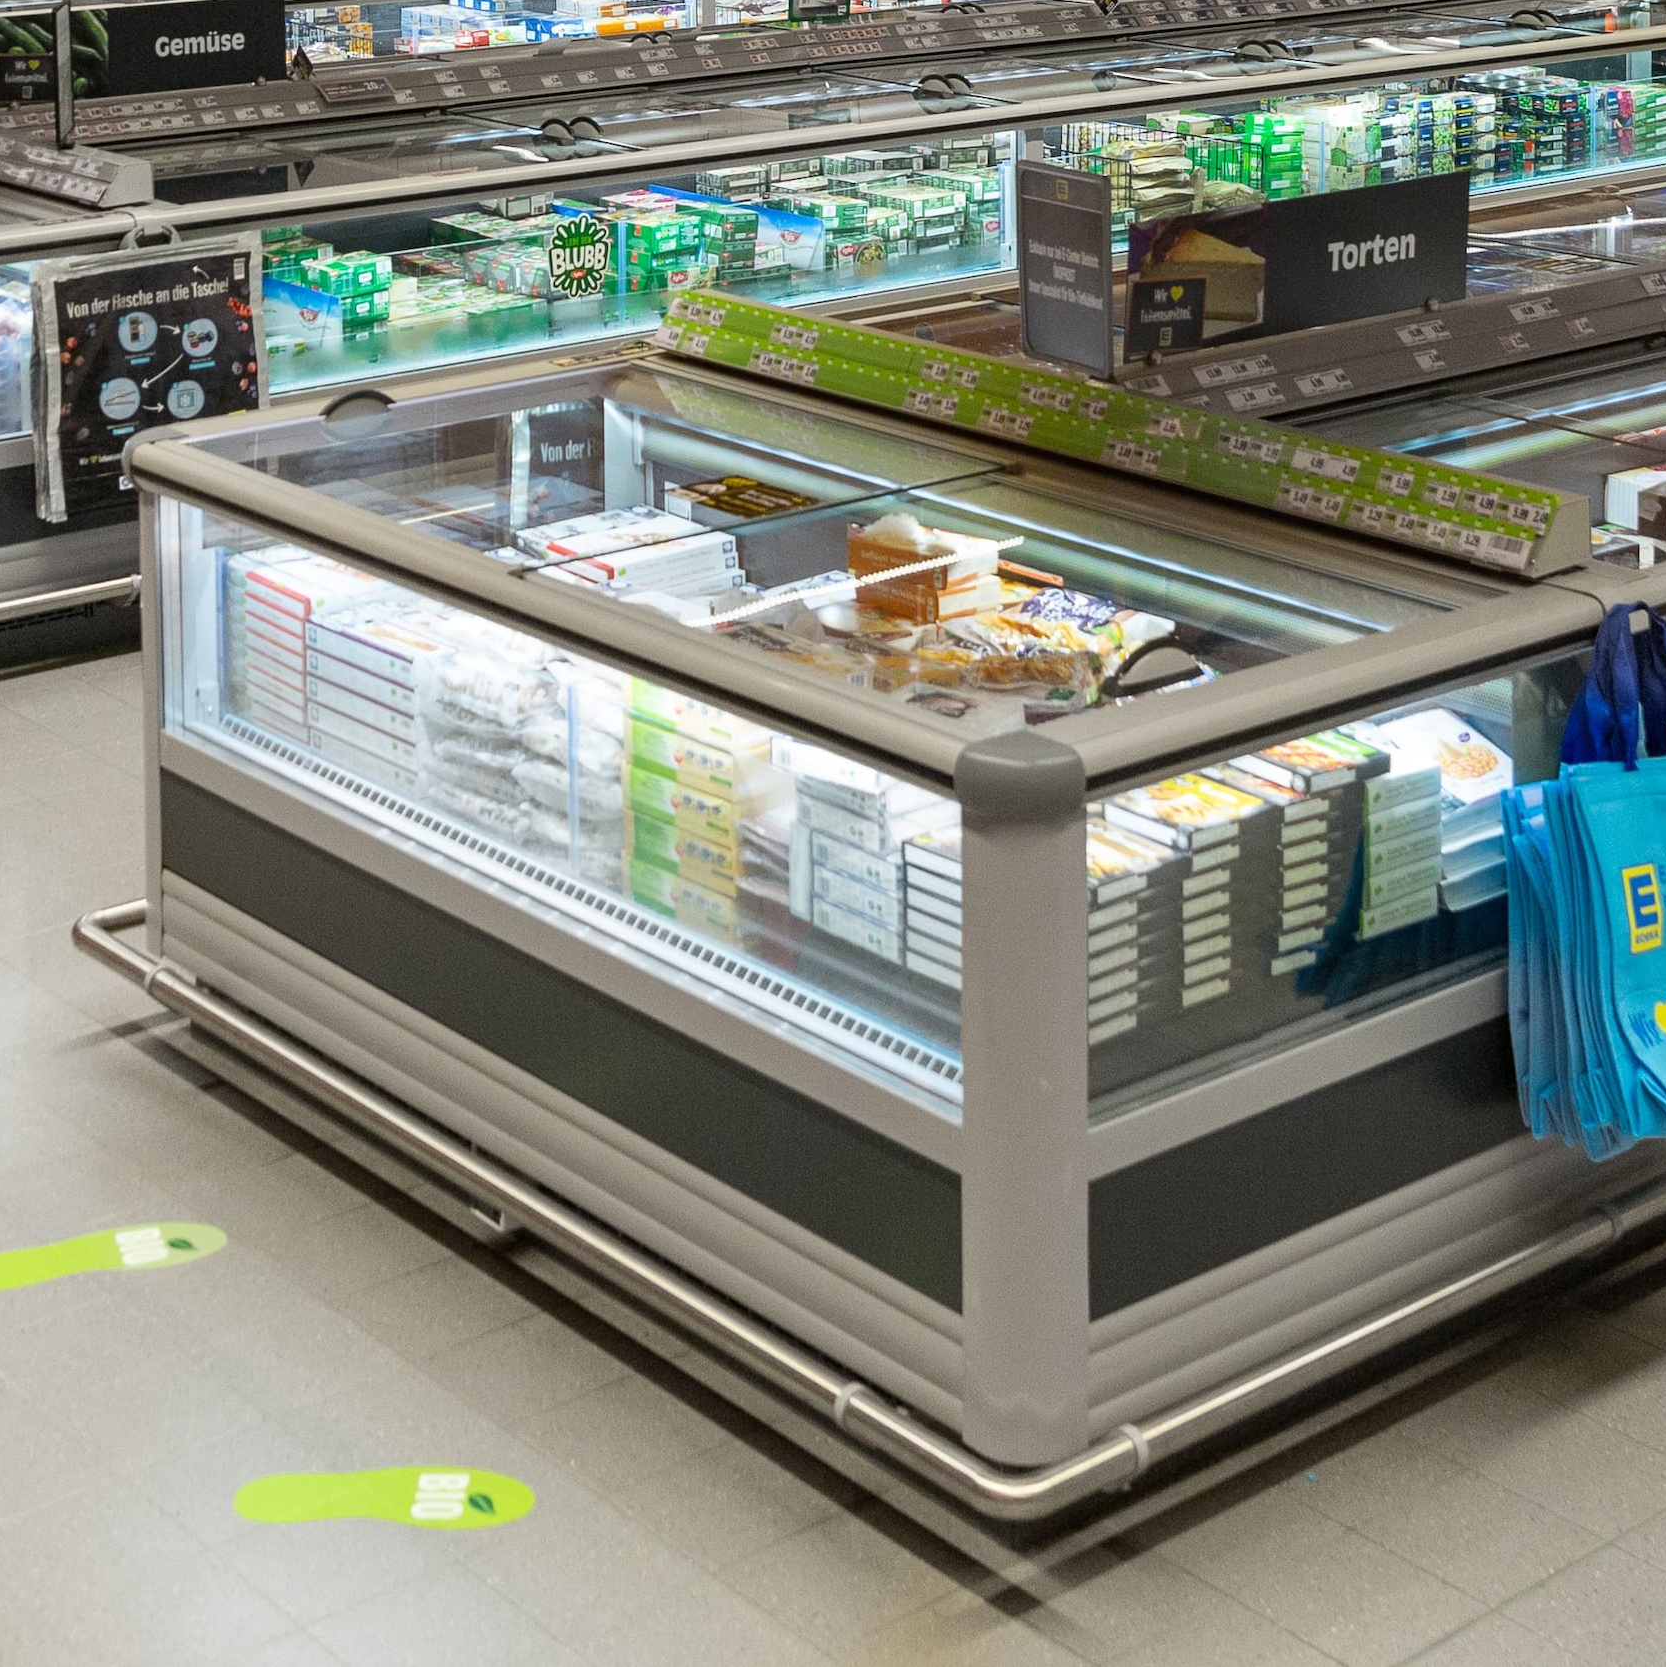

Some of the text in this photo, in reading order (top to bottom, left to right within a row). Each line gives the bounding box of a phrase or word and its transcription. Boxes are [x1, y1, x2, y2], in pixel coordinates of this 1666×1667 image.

[154, 31, 245, 58] Gemüse
[550, 242, 607, 276] BLUBB
[1327, 233, 1416, 272] Torten
[66, 300, 89, 320] Von
[90, 297, 110, 316] der
[156, 290, 171, 303] an
[172, 285, 190, 302] die
[191, 277, 229, 299] Tasche!
[1478, 496, 1495, 511] 4.99
[1629, 873, 1659, 929] E
[410, 1472, 471, 1520] BIO
